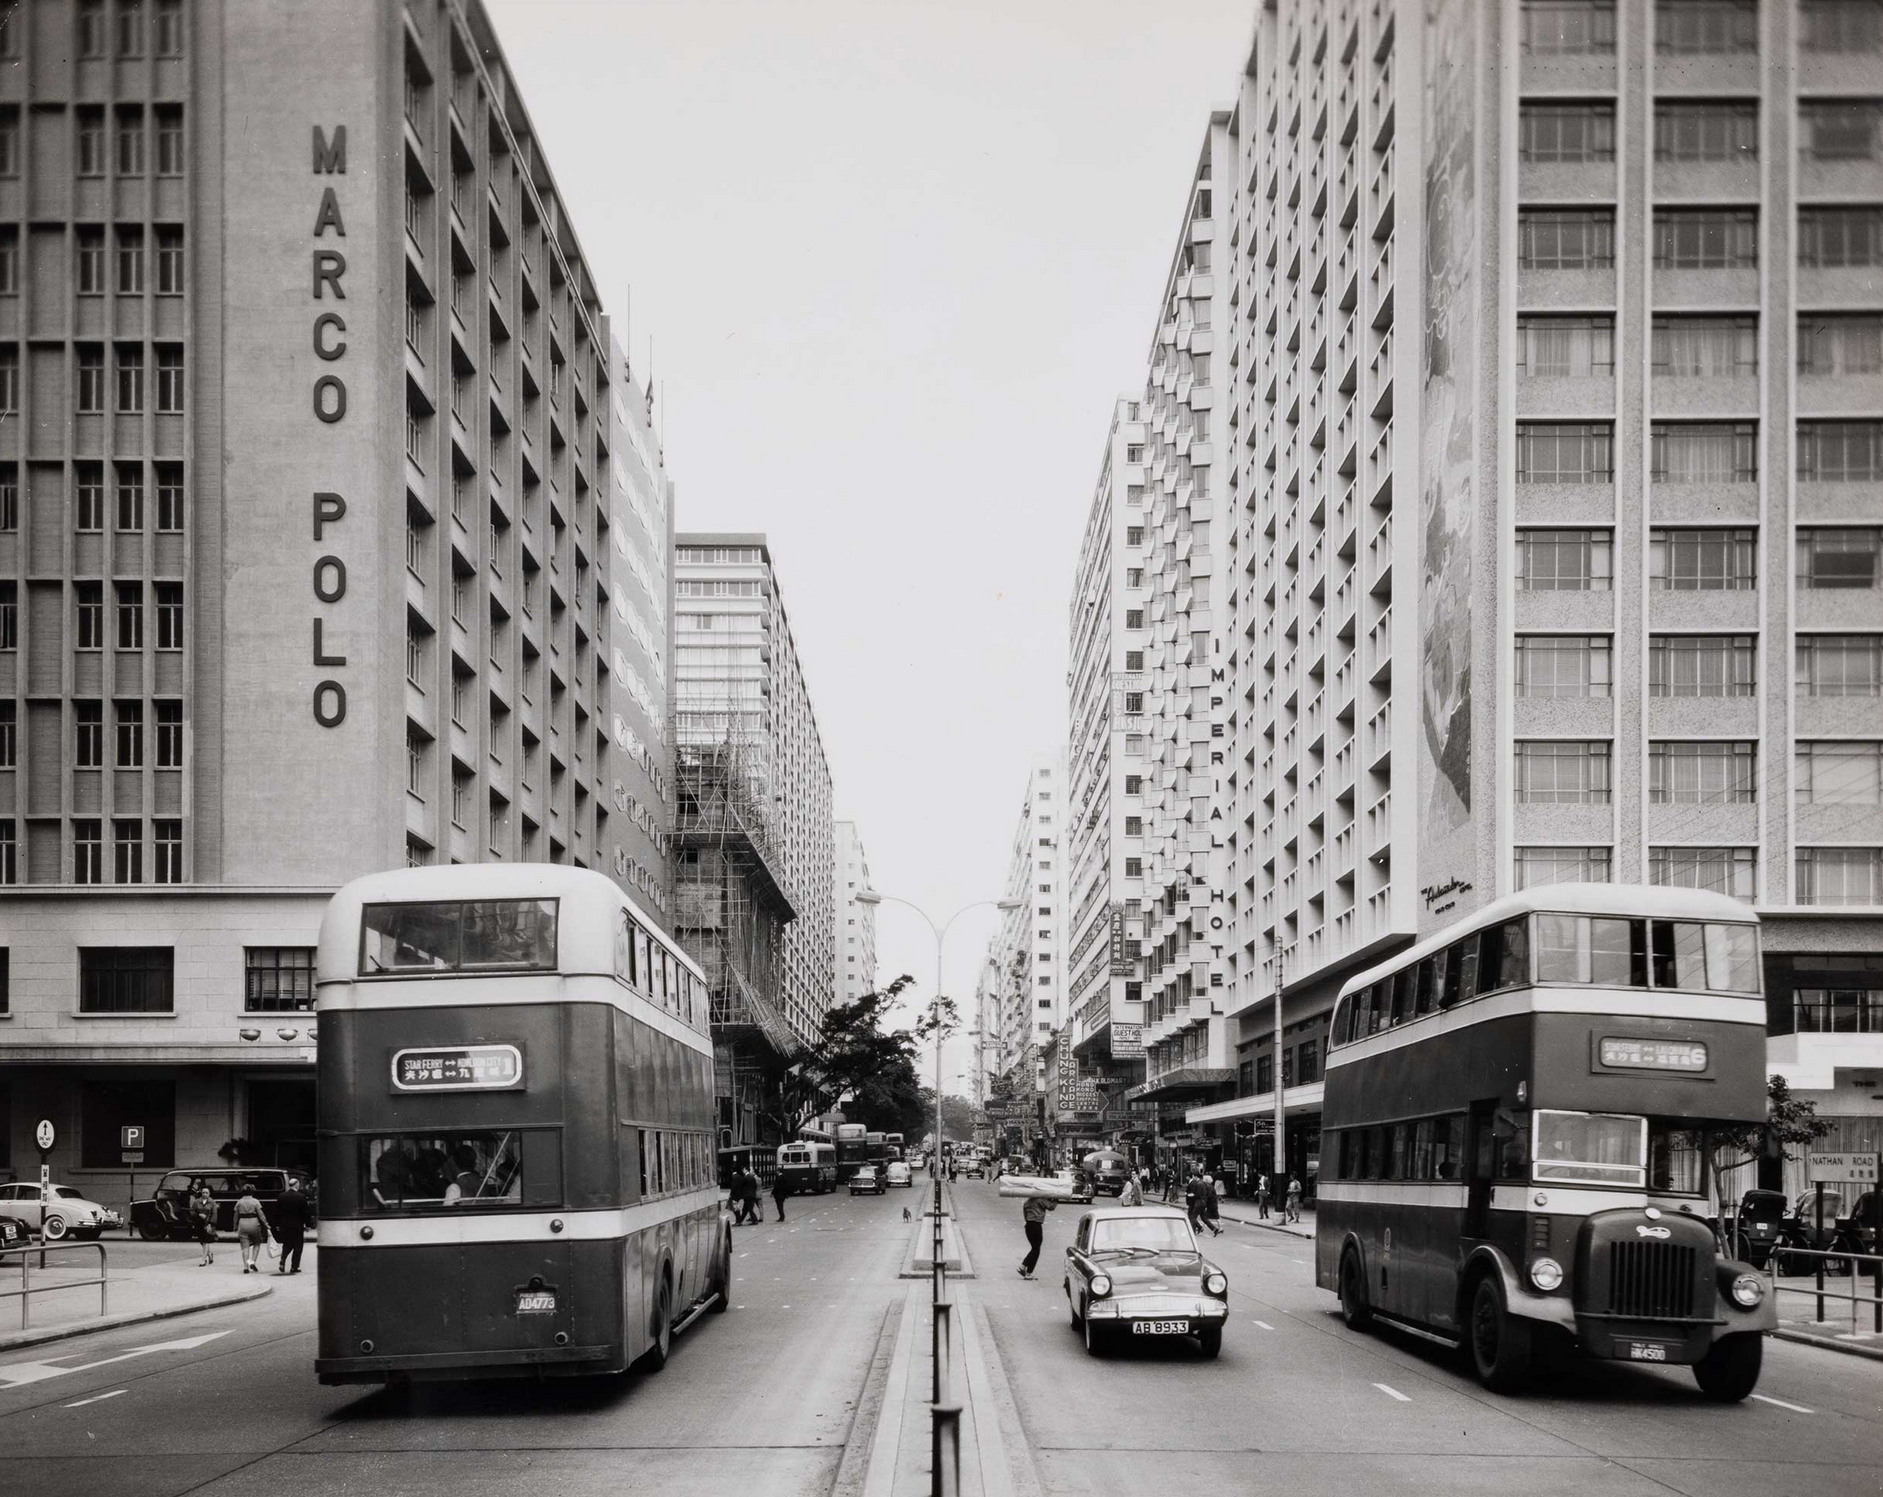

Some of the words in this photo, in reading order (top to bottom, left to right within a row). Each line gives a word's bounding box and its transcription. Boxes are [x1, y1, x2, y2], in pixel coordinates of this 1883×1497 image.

[312, 124, 347, 424] MARCO
[312, 492, 347, 728] POLO
[1211, 638, 1225, 848] IMPERIAL
[1210, 889, 1224, 1015] HOTEL
[404, 1060, 421, 1070] STAR
[422, 1059, 443, 1069] FERRY
[1060, 1037, 1069, 1075] CHUNG
[1060, 1079, 1069, 1109] KING
[128, 1129, 139, 1146] P
[1812, 1156, 1844, 1166] NATHAN
[1852, 1156, 1874, 1167] ROAD
[518, 1297, 555, 1310] AD4773
[1135, 1322, 1151, 1334] AB
[1155, 1321, 1187, 1333] 8933
